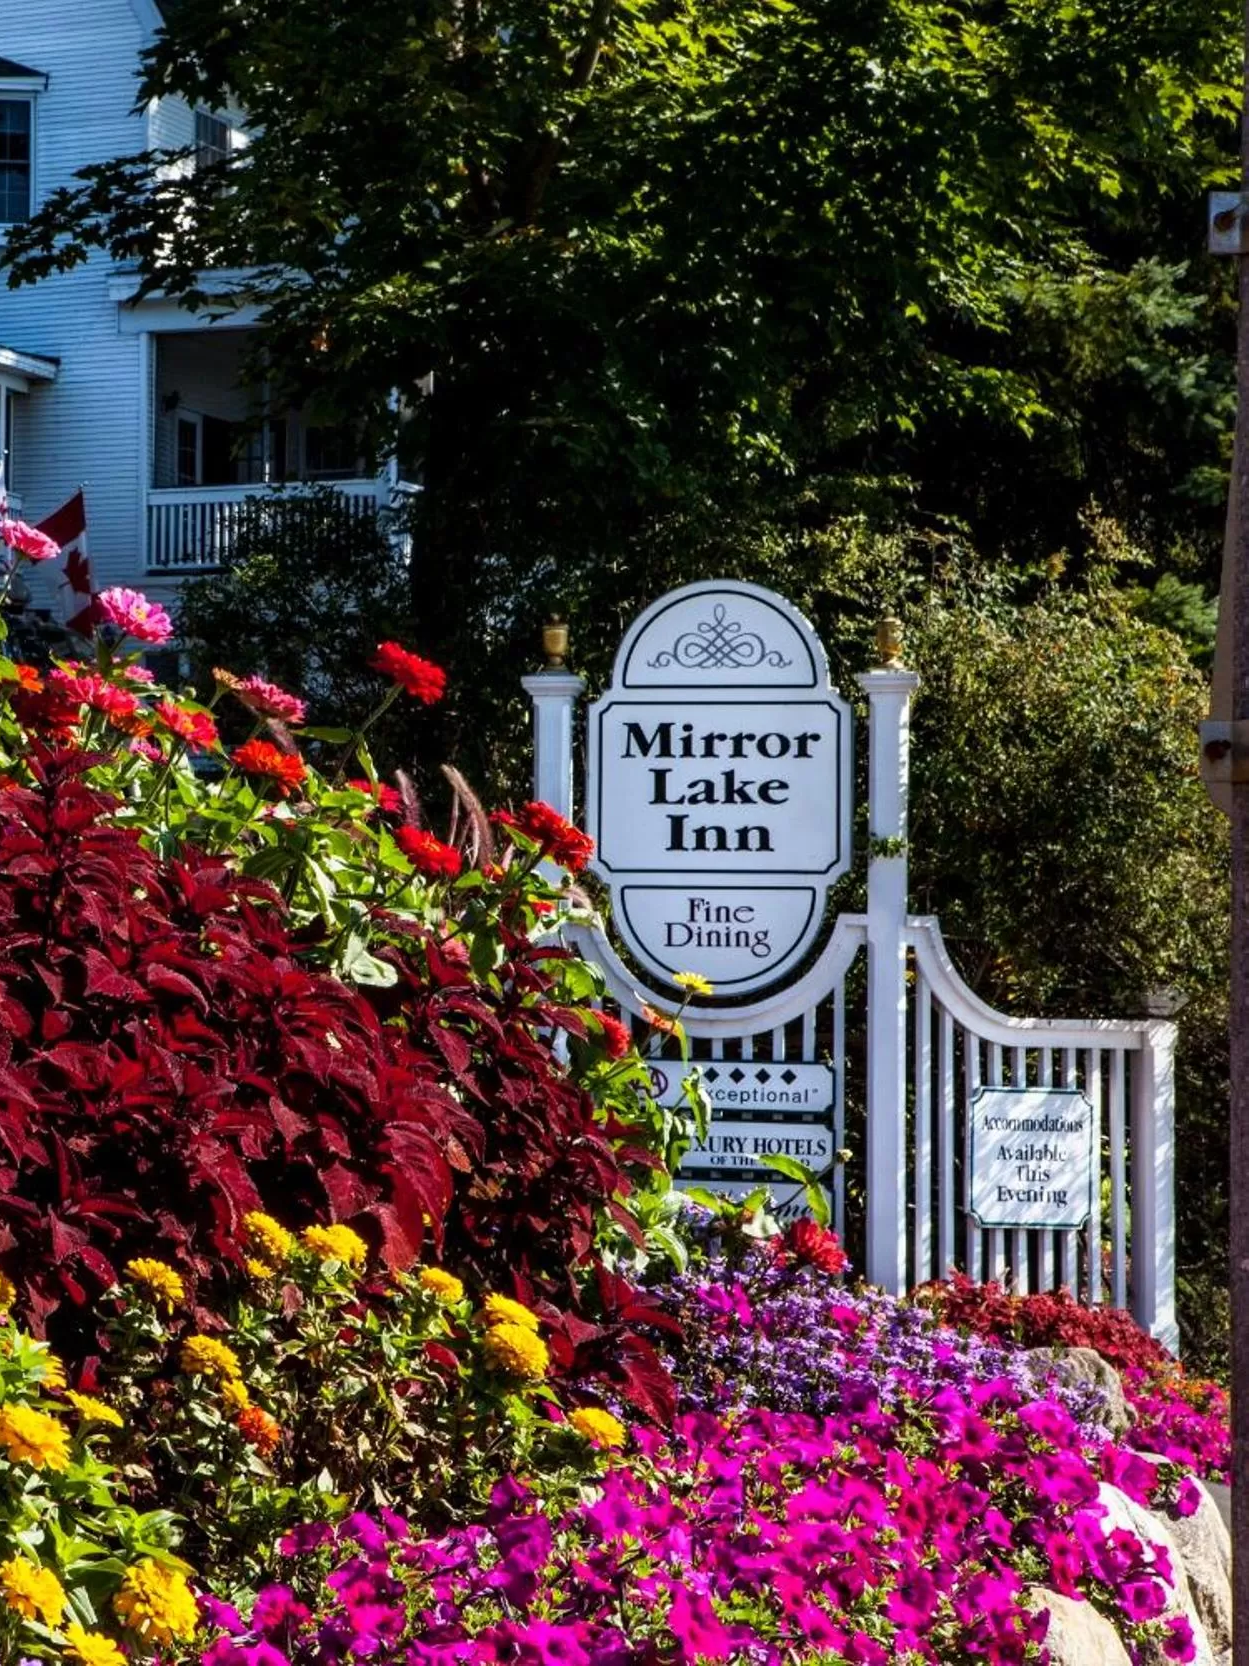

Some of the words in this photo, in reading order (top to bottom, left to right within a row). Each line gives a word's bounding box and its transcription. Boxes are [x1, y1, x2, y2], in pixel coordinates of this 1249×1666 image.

[621, 722, 821, 759] Mirror
[648, 768, 790, 805] Lake
[665, 814, 775, 852] Inn
[688, 898, 755, 923] Fine
[664, 921, 772, 958] Dining
[982, 1115, 1084, 1132] Accommodations
[693, 1136, 748, 1153] XURY
[753, 1137, 827, 1156] HOTELS
[996, 1144, 1067, 1162] Available
[710, 1155, 727, 1166] OF
[1016, 1164, 1050, 1182] This
[996, 1185, 1068, 1209] Evening
